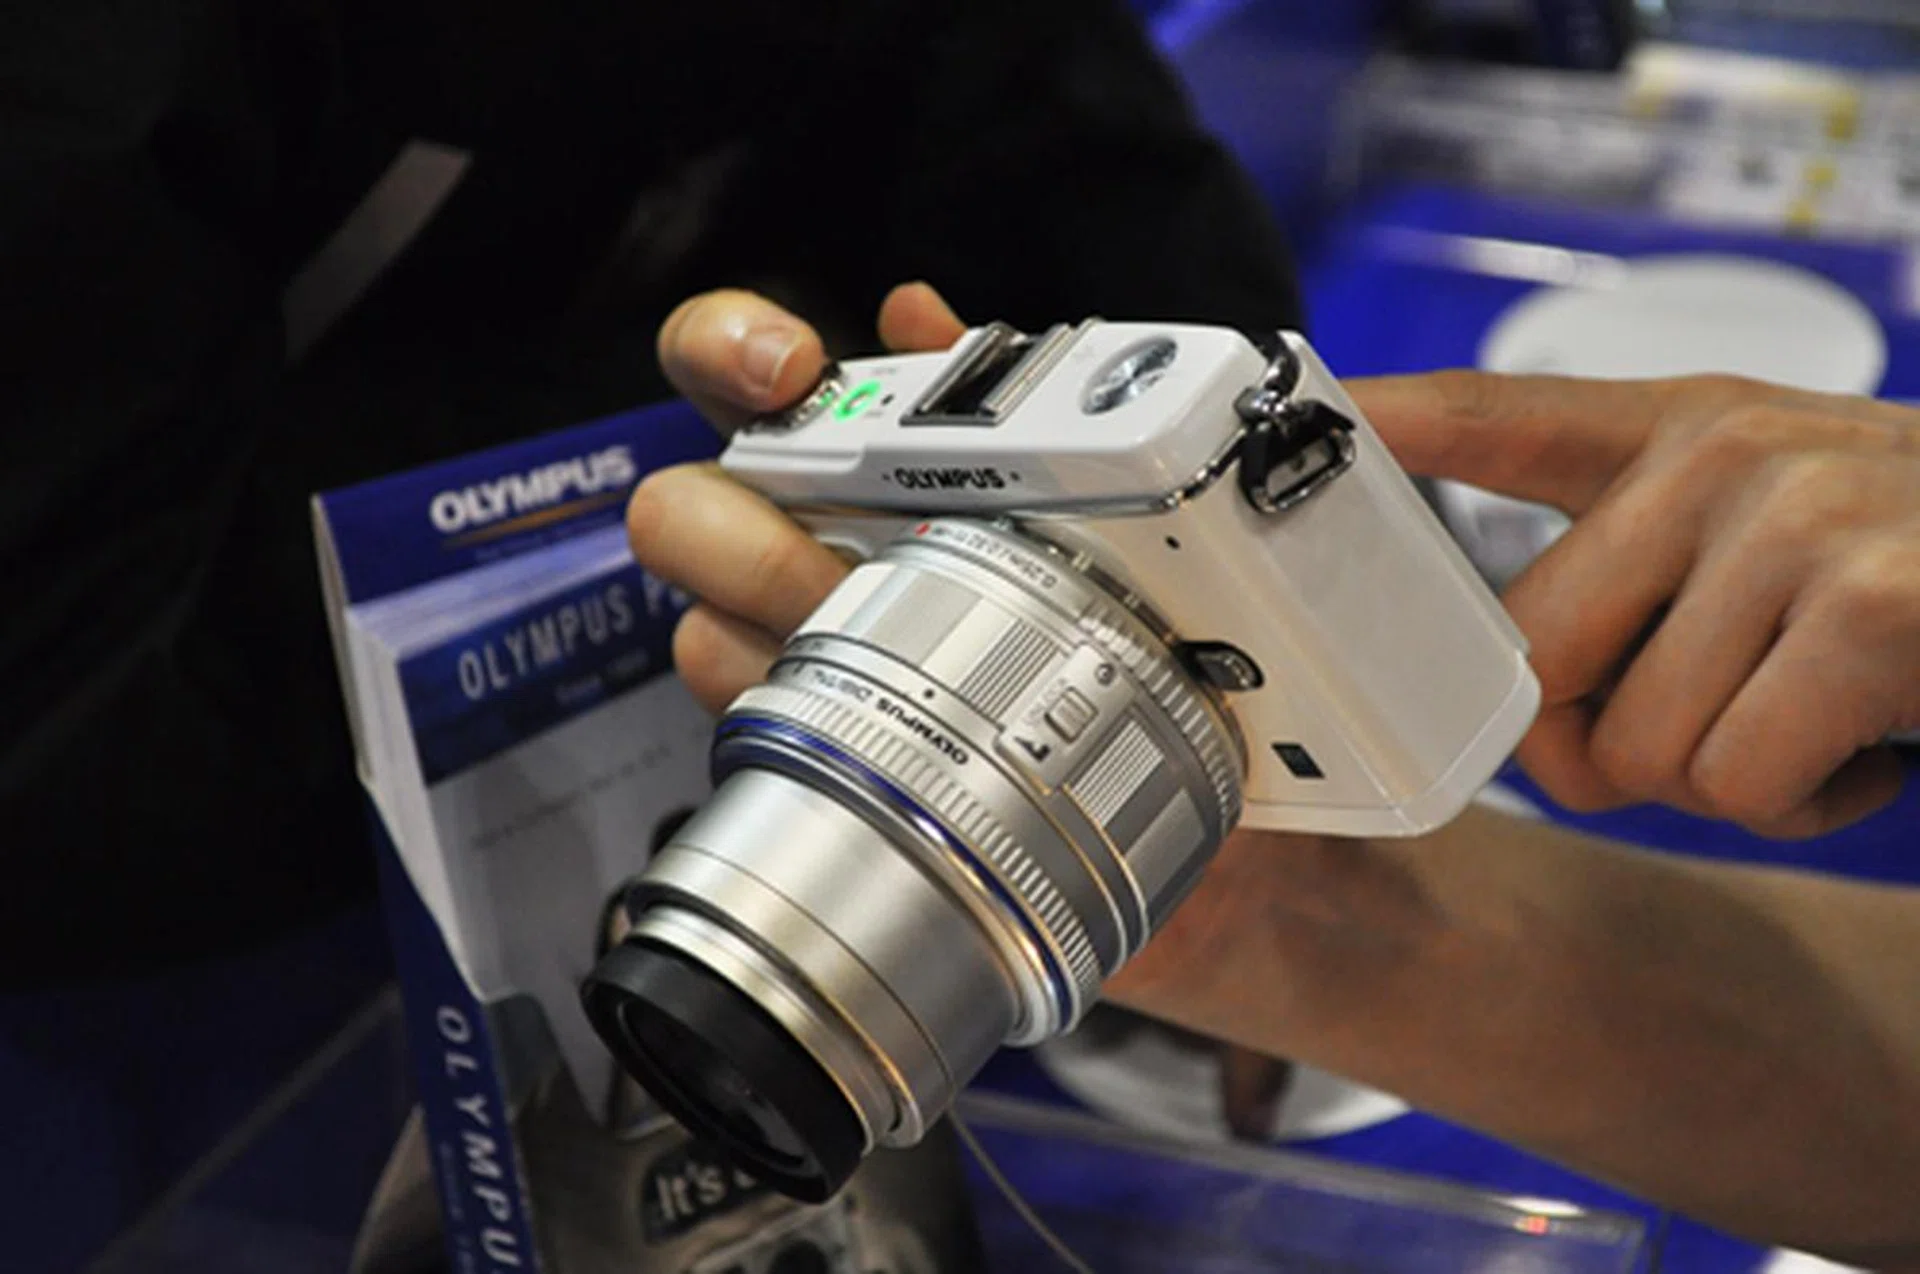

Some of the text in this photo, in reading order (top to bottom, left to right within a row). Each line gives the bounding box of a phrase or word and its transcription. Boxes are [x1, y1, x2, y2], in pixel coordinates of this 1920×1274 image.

[429, 445, 637, 533] OLYMPUS
[894, 467, 1006, 490] OLYMPUS
[457, 584, 634, 700] OLYMPUS
[876, 698, 969, 766] OLYMPUS
[436, 1004, 521, 1274] OLYMPU
